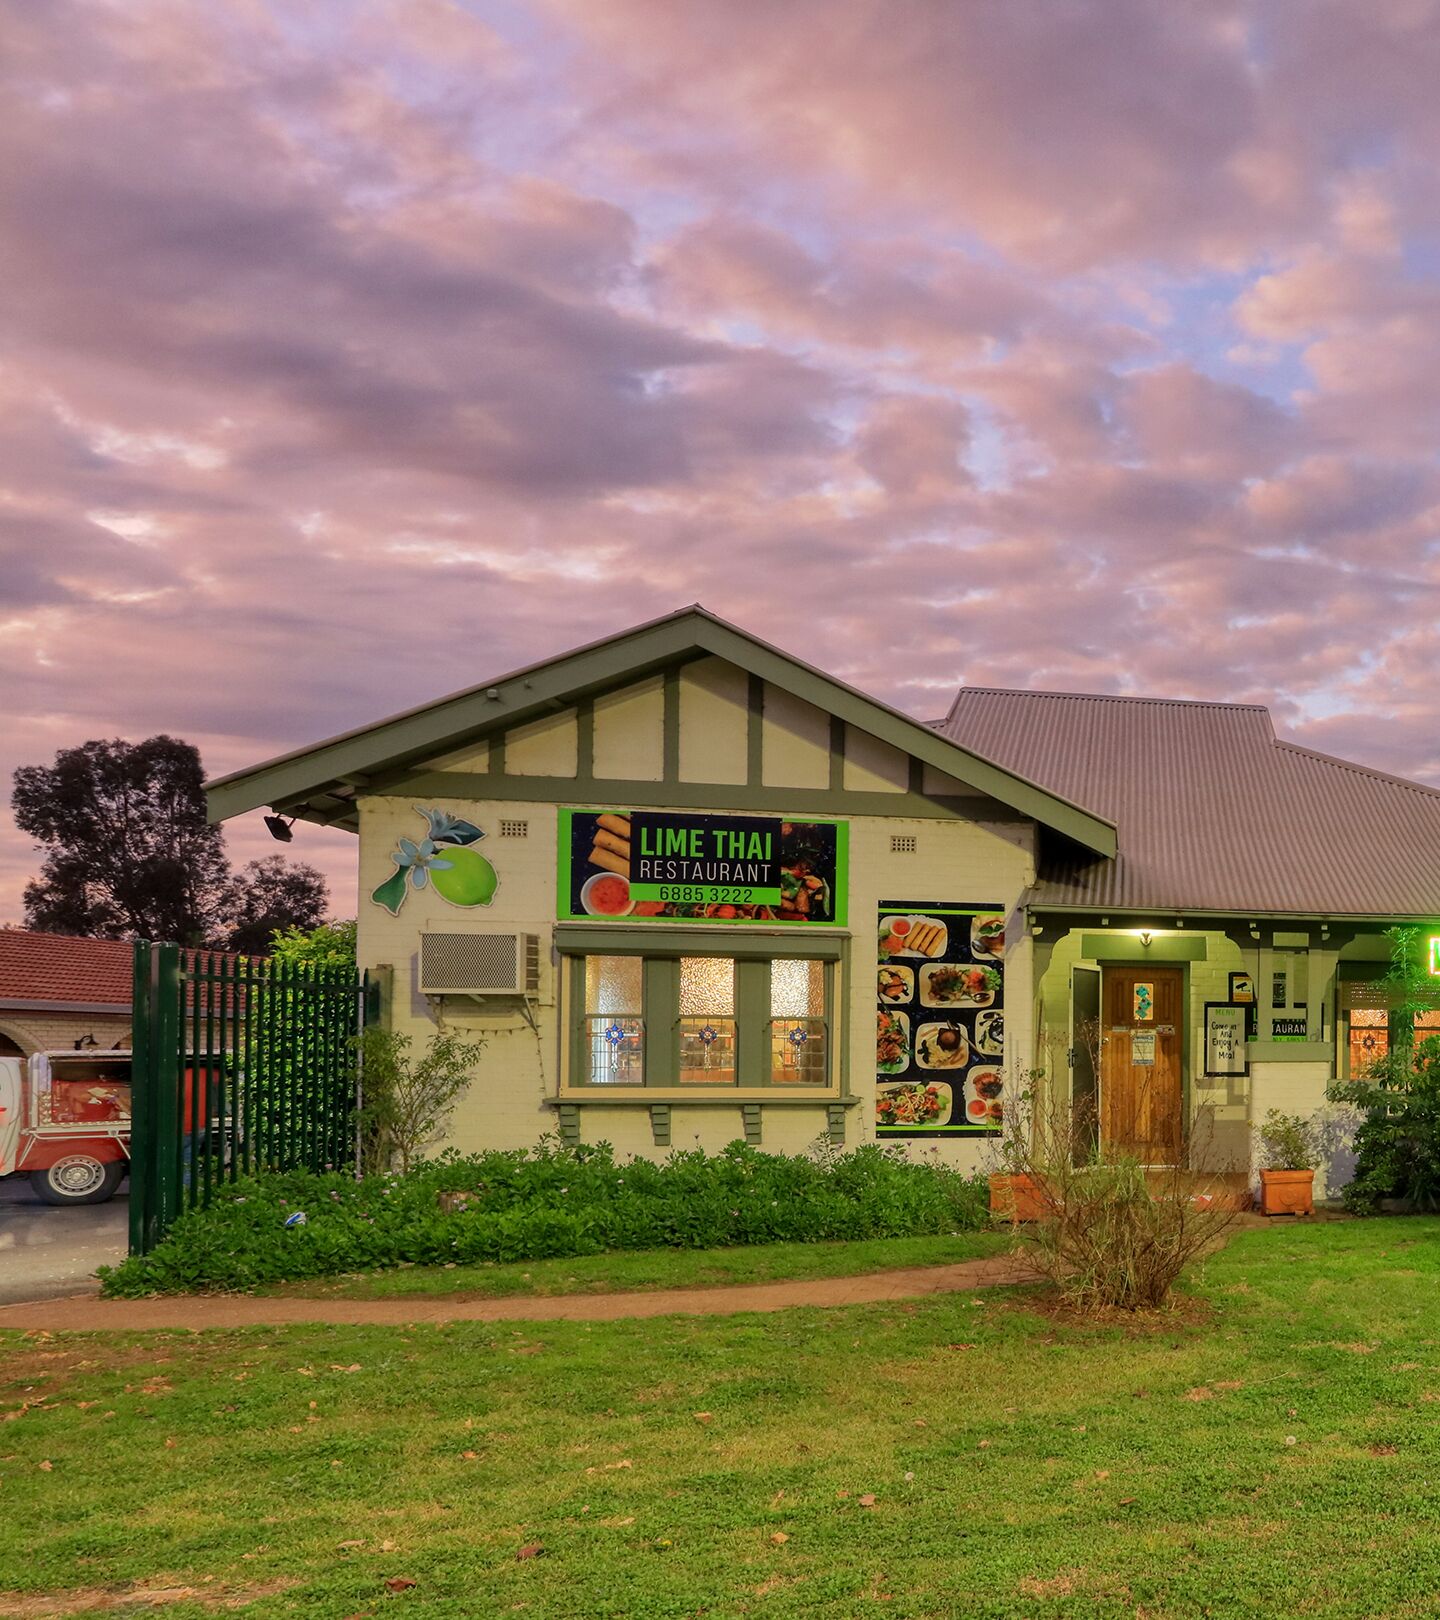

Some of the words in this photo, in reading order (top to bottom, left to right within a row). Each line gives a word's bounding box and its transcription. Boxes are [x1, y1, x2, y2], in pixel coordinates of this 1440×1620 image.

[640, 827, 705, 858] LIME
[712, 829, 772, 860] THAI
[640, 859, 772, 883] RESTAURANT
[660, 886, 704, 902] 6885
[710, 888, 753, 903] 3222
